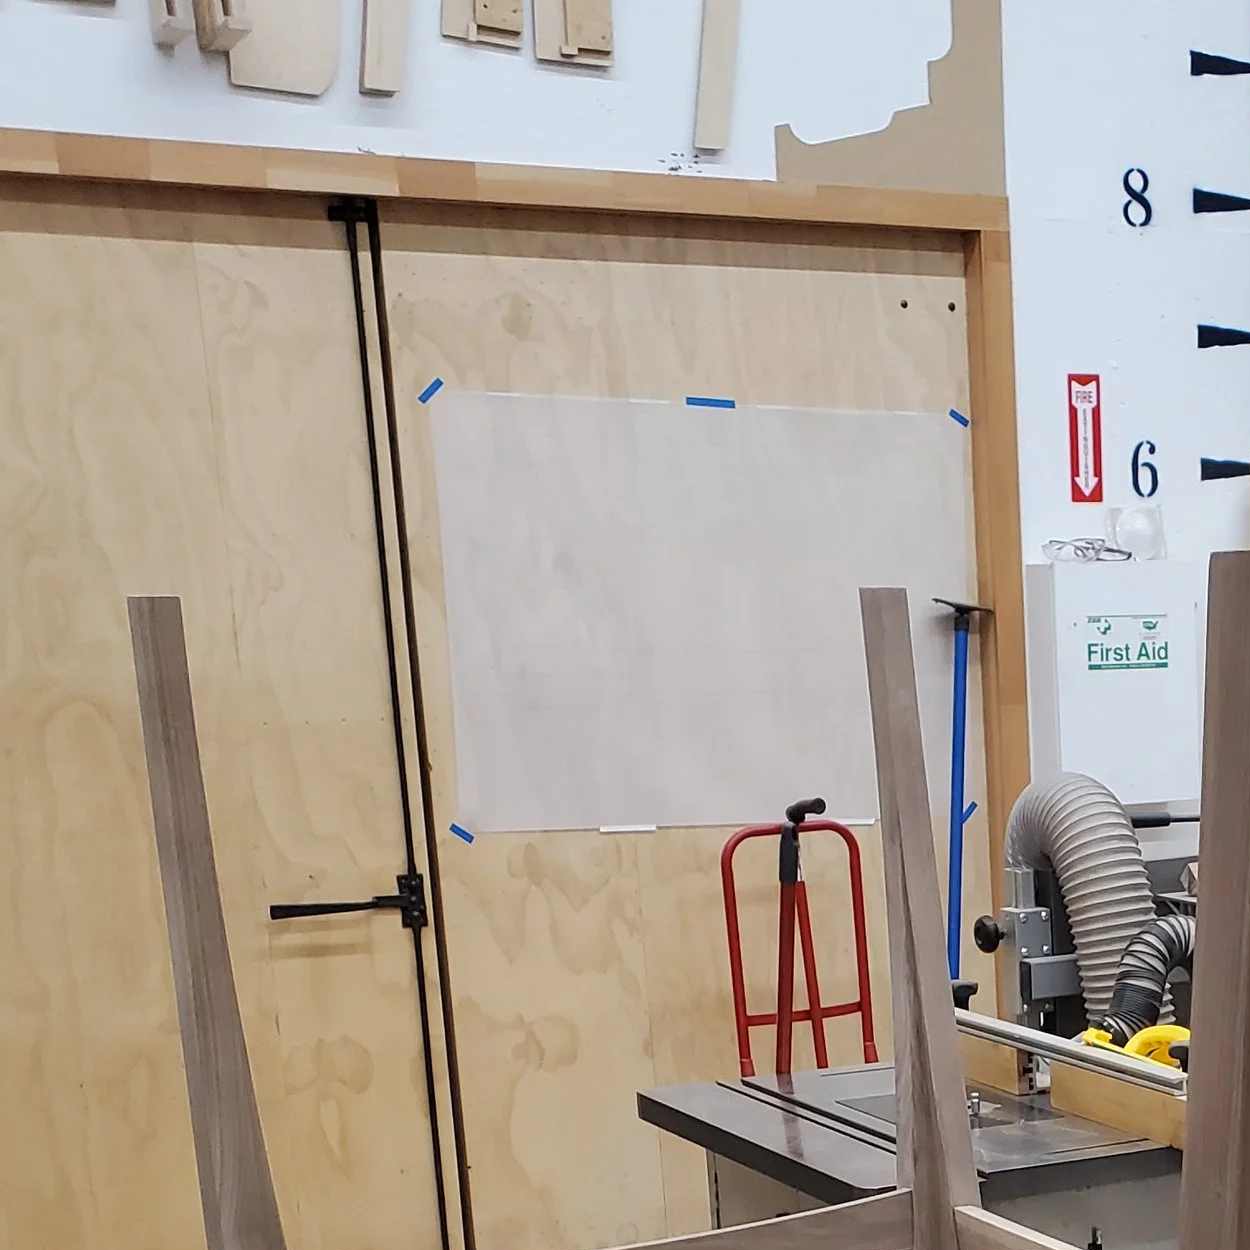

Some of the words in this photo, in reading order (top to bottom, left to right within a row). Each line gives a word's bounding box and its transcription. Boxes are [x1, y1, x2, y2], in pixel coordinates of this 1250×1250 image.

[1122, 167, 1152, 227] 8
[1075, 390, 1093, 404] FIRE
[1131, 440, 1158, 497] 6
[1087, 642, 1130, 662] First
[1136, 641, 1168, 660] Aid
